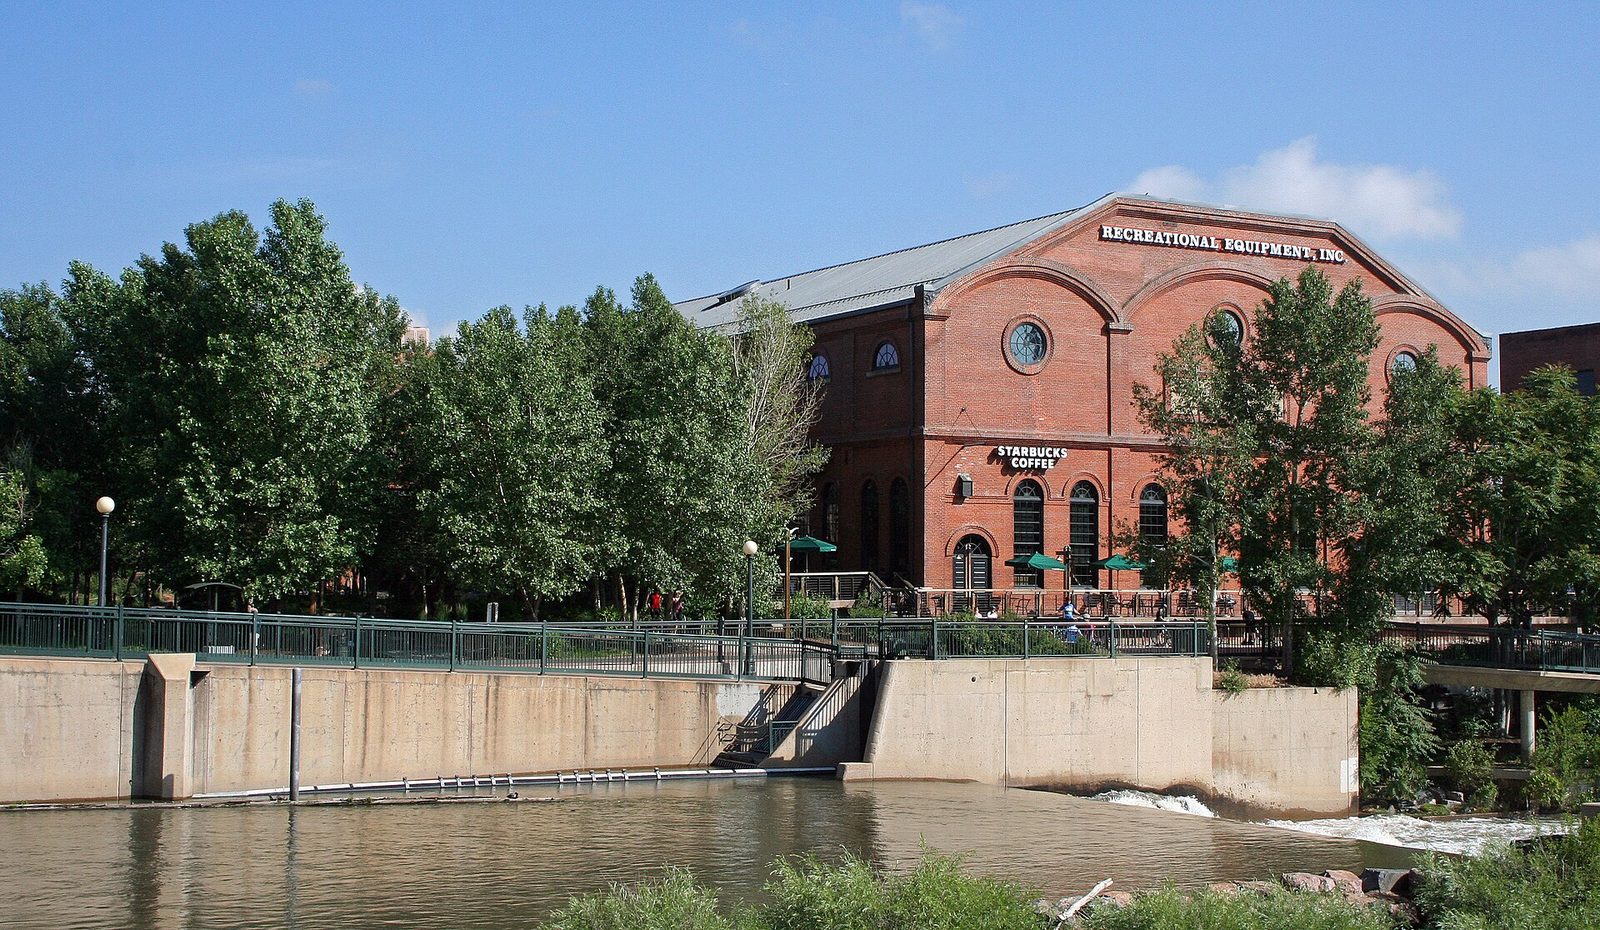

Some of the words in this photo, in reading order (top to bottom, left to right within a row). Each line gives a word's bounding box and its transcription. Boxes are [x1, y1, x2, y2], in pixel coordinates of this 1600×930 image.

[1102, 225, 1219, 249] RECREATIONAL
[1224, 238, 1316, 260] EQUIPMENT,
[1319, 248, 1348, 263] INC.
[998, 445, 1068, 458] STARBUCKS
[1011, 457, 1055, 469] COFFEE
